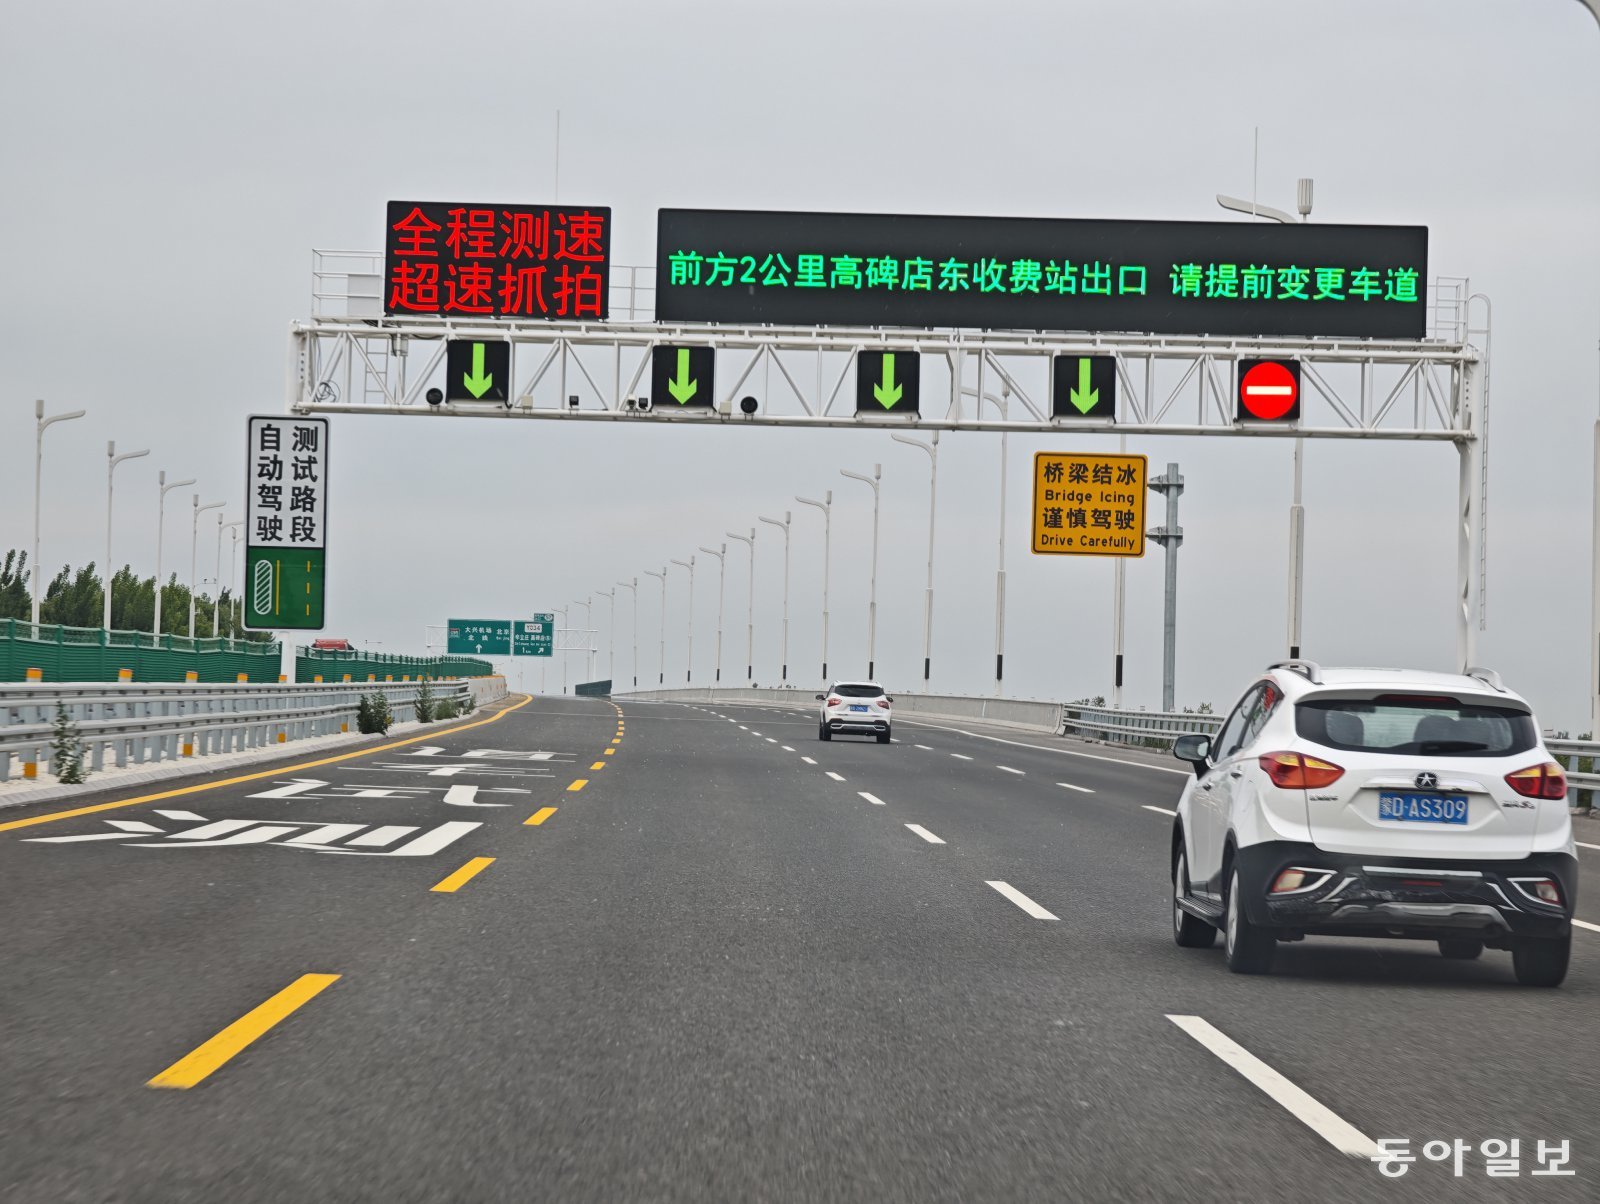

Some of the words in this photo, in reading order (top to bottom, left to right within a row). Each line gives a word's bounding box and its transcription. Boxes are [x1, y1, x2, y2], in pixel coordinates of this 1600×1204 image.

[392, 207, 605, 262] 全程测速
[389, 260, 602, 316] 超速抓拍
[668, 250, 1148, 296] 前方2公里高碑店东收费站出口
[1169, 263, 1419, 303] 请提前变更车道
[256, 423, 283, 542] 自动驾驶
[289, 425, 319, 543] 测试路段
[1043, 462, 1136, 485] 桥梁结冰
[1045, 489, 1092, 504] Bridge
[1100, 491, 1135, 506] Icing
[1041, 534, 1073, 546] Drive
[1080, 535, 1135, 550] Carefully
[1042, 507, 1135, 530] 谨慎驾驶
